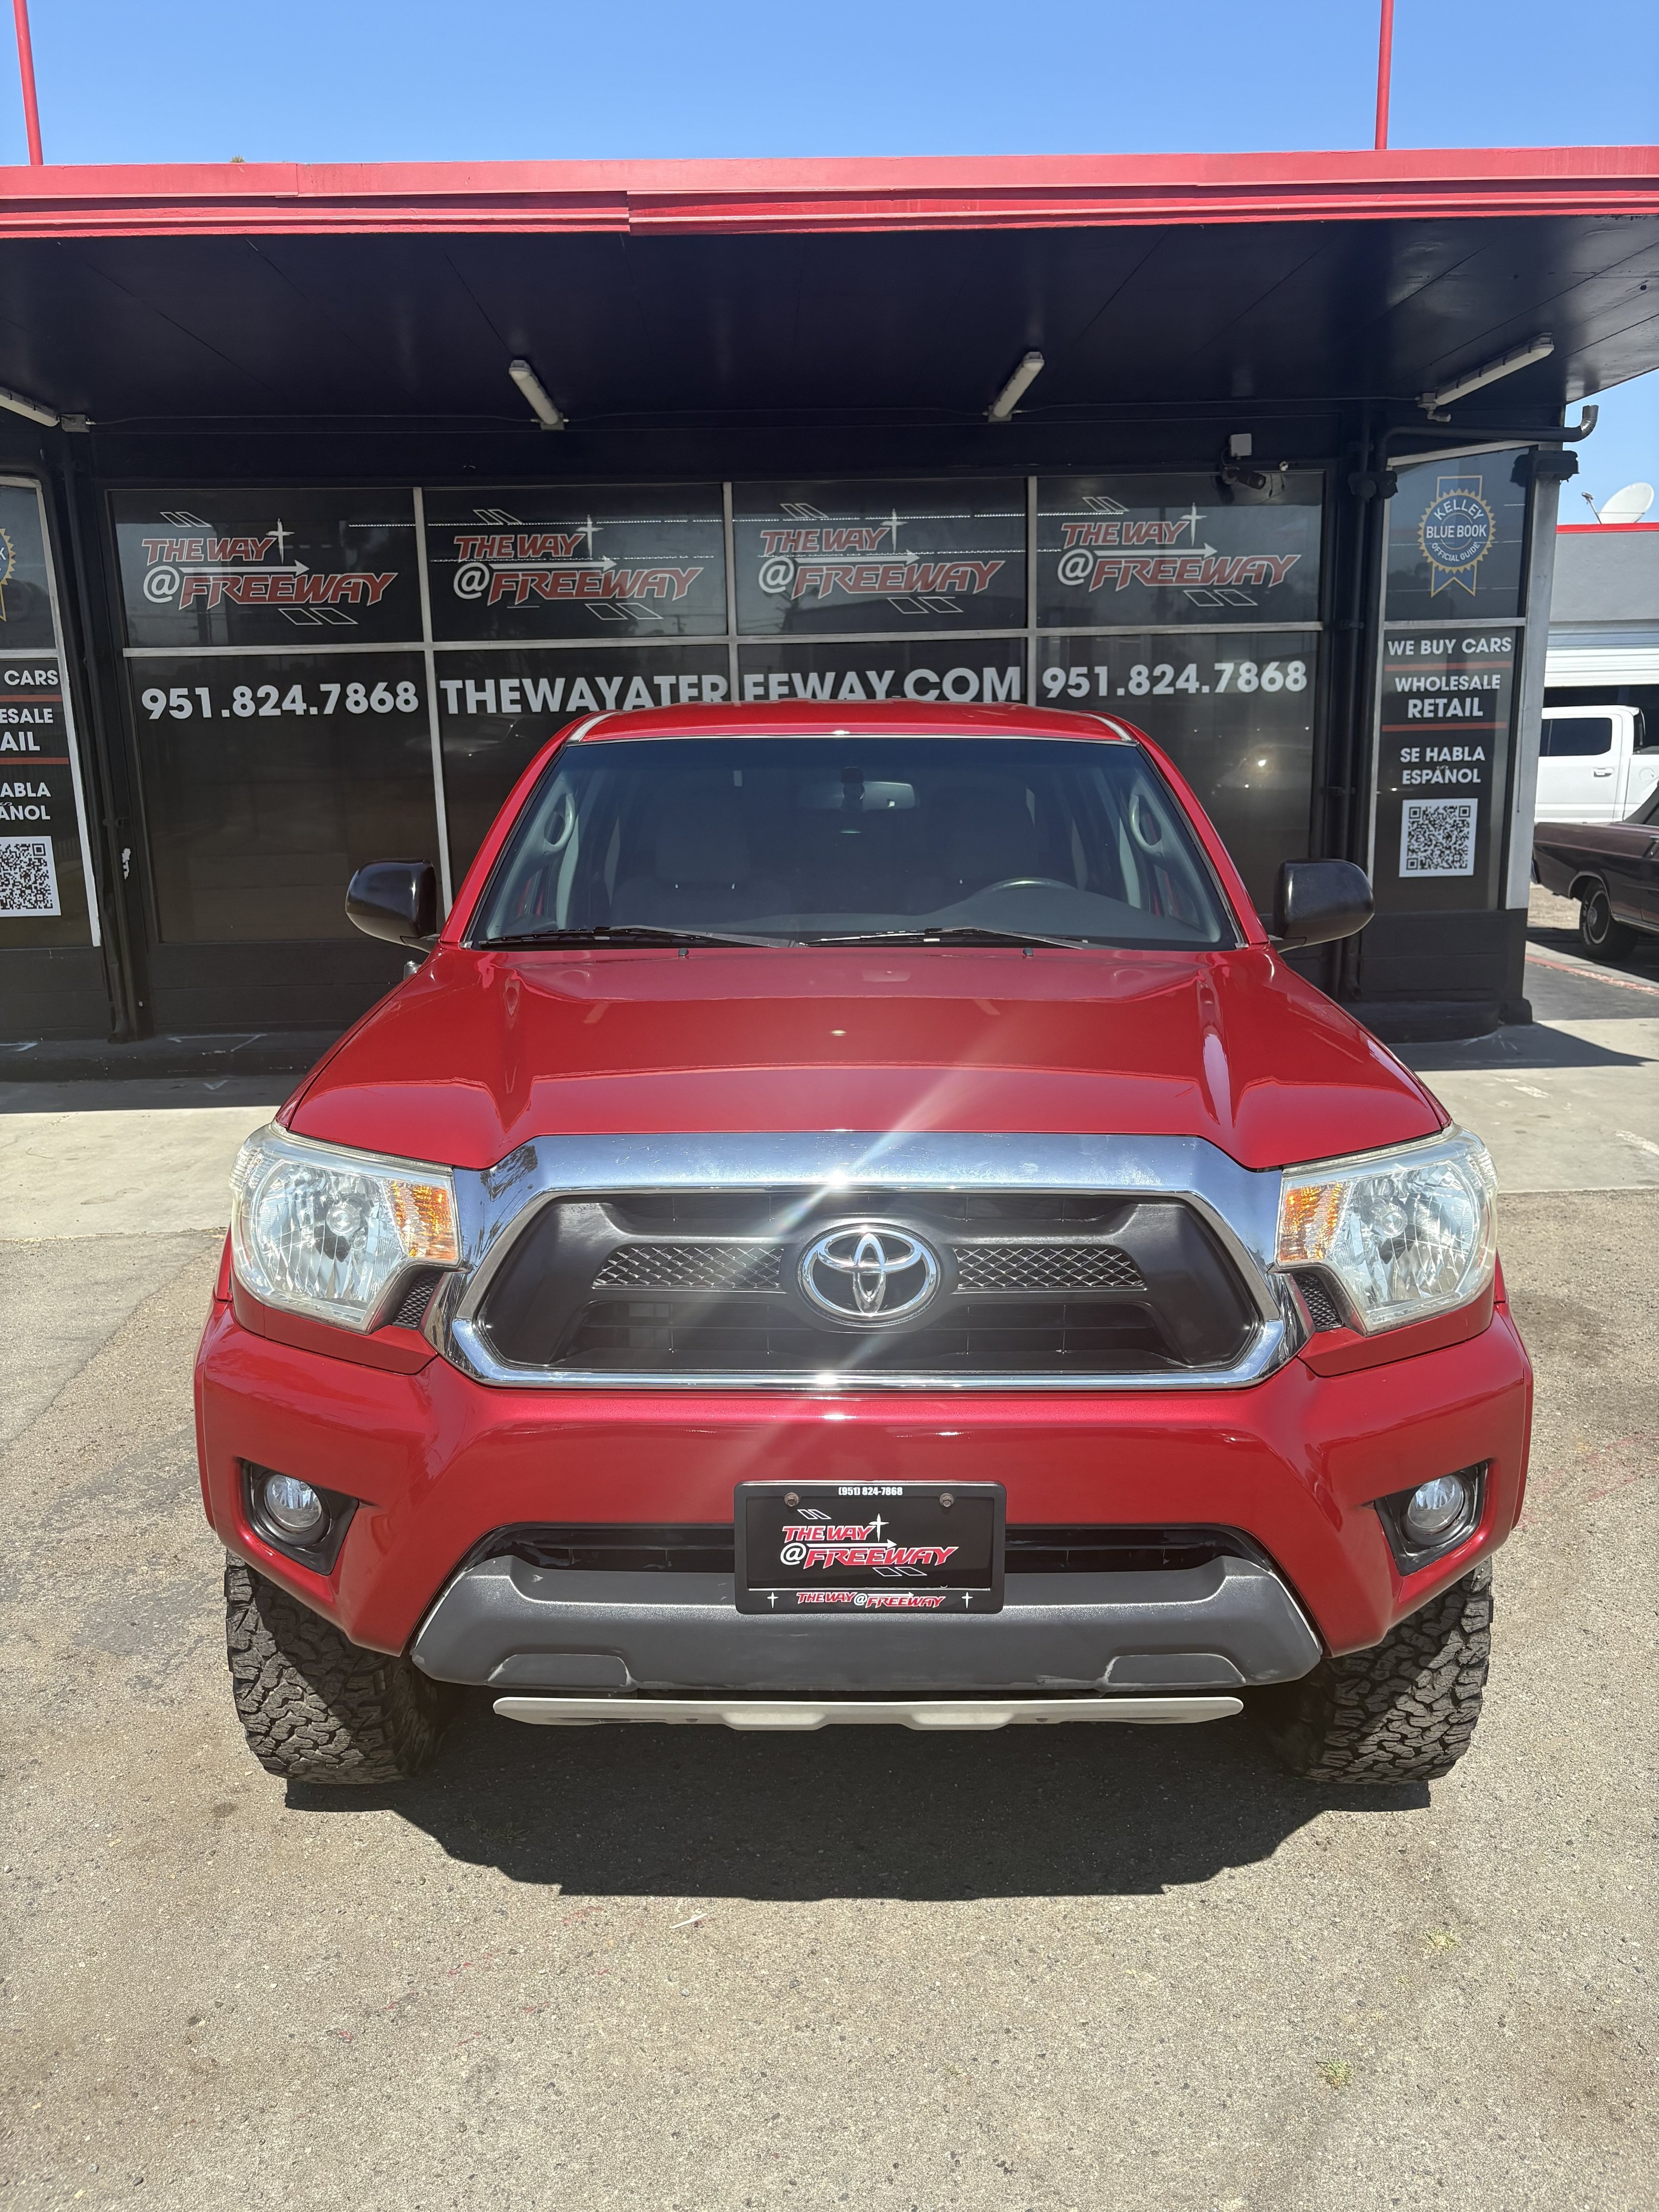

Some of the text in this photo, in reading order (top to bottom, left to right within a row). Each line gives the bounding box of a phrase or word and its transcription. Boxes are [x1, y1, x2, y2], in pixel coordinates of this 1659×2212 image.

[1434, 499, 1484, 521] KELLEY
[1426, 524, 1487, 539] BLUE BOOK
[1432, 541, 1480, 562] OFFICIAL GUIDE
[1388, 637, 1512, 656] WE BUY CARS
[4, 670, 58, 686] CARS
[1042, 660, 1307, 698] 951.824.7868
[1395, 674, 1501, 692] WHOLESALE
[141, 680, 419, 720] 951.824.7868
[440, 667, 1021, 714] THEWAYATFREEWAYCOM
[1408, 697, 1483, 719] RETAIL
[1400, 746, 1485, 763] SE HABLA
[1402, 765, 1481, 785] ESPAÑOL
[838, 1486, 903, 1496] (951) 824-7868
